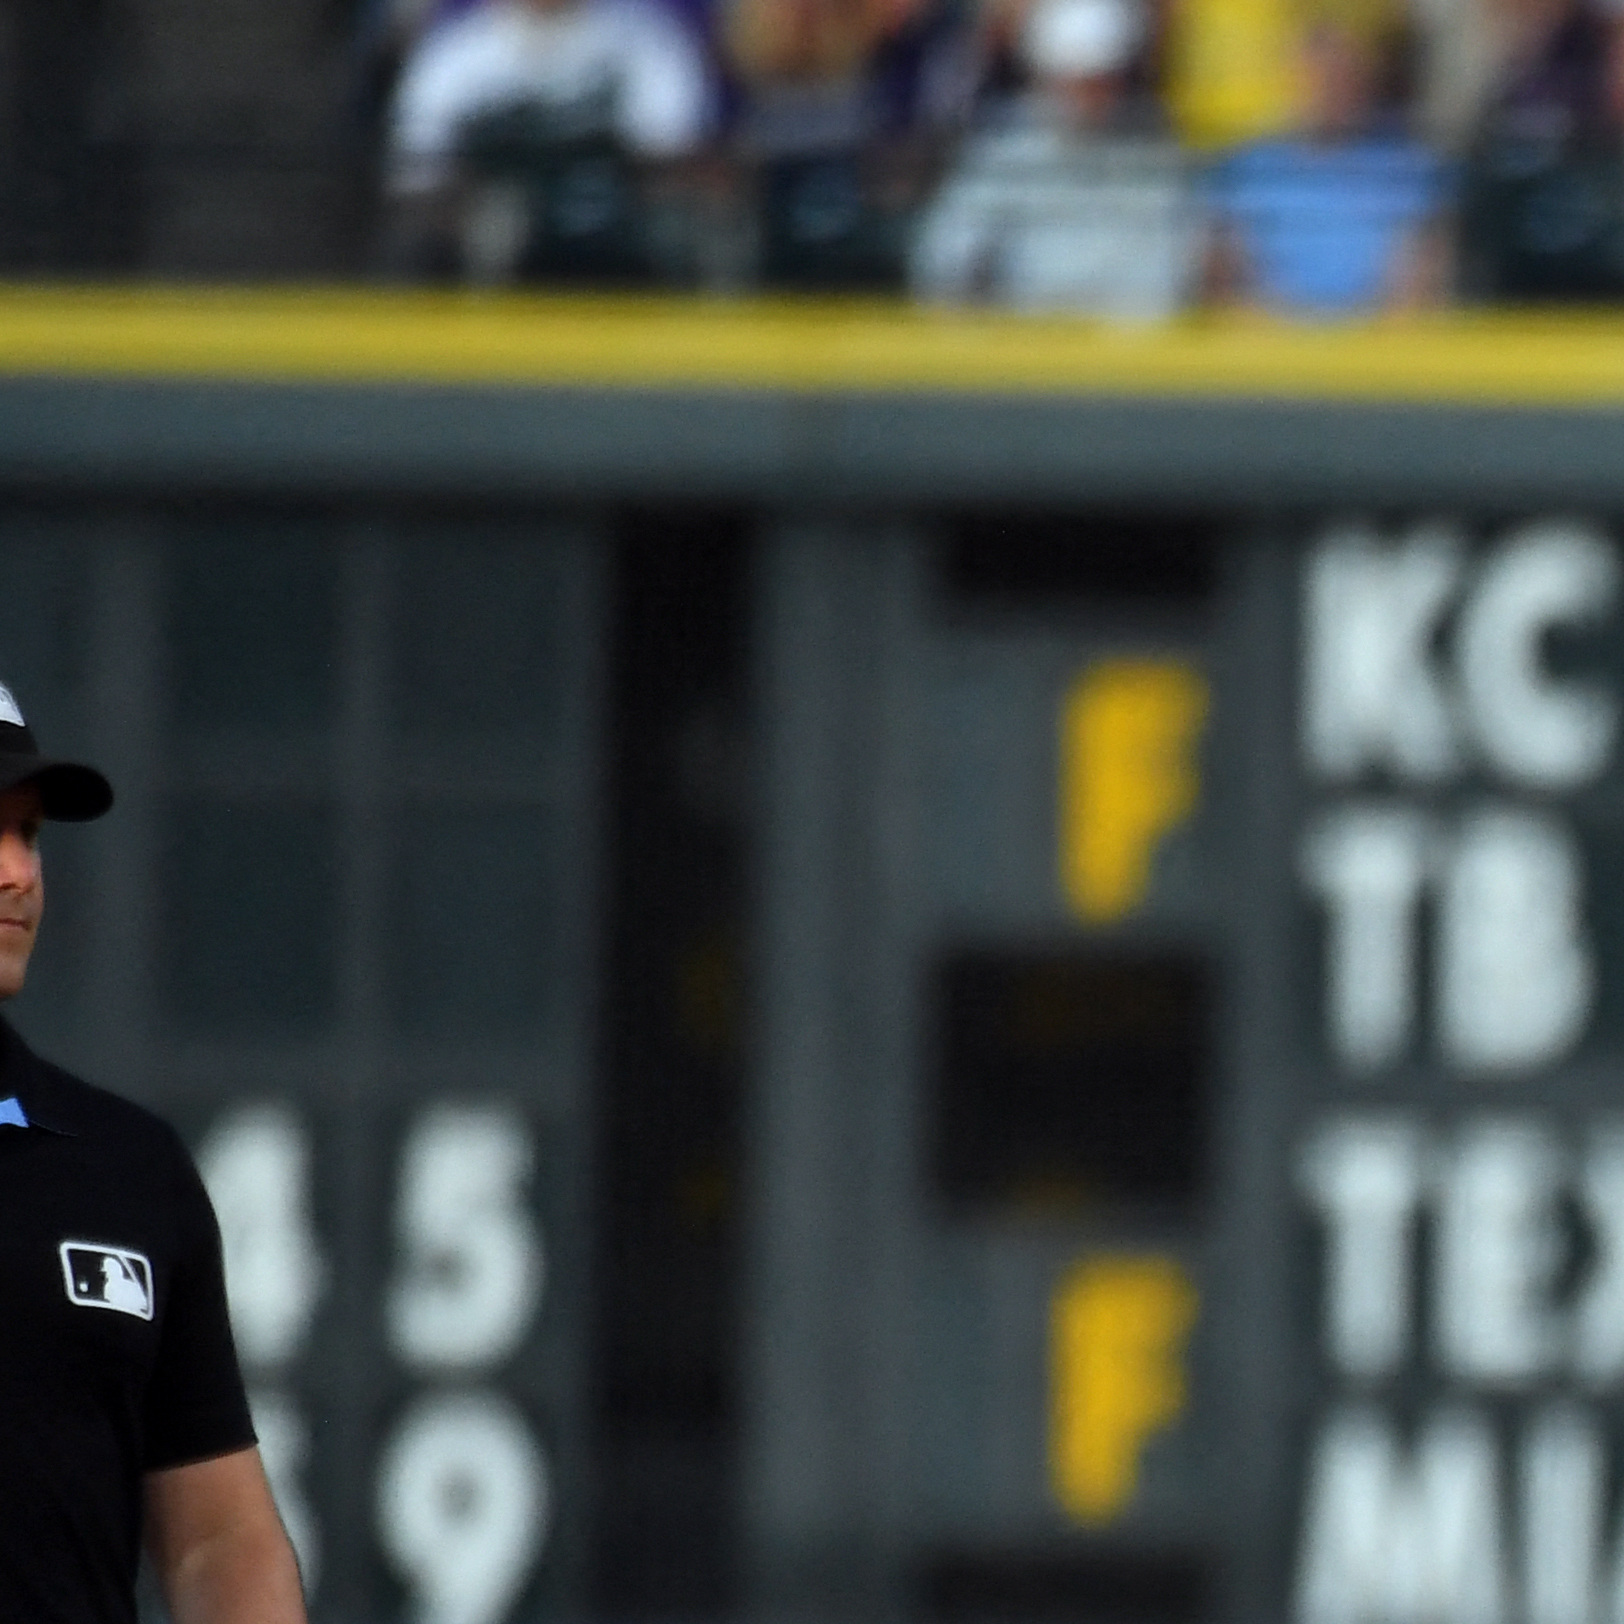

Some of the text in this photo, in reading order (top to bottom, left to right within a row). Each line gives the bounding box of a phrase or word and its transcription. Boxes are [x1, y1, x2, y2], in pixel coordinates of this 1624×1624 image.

[1303, 528, 1615, 785] KC
[1064, 667, 1202, 920] F
[1303, 817, 1590, 1075] TB
[392, 1107, 540, 1370] 5
[1052, 1257, 1198, 1520] F
